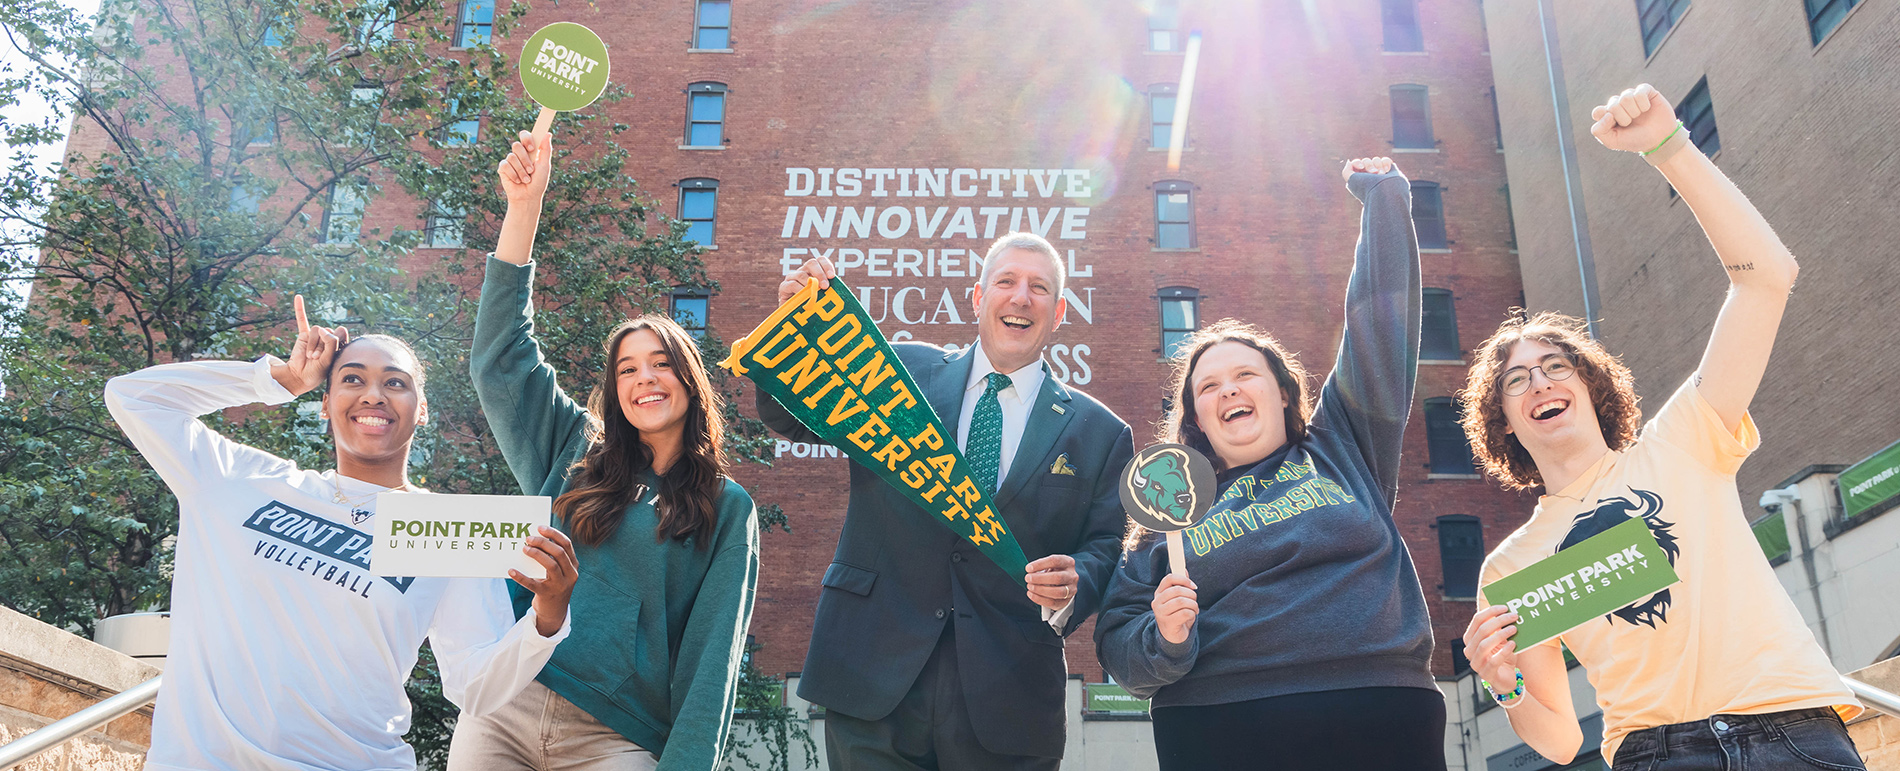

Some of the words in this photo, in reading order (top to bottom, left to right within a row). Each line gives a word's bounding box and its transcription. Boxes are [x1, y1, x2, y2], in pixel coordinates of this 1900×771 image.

[534, 51, 585, 85] PARK
[540, 38, 599, 74] POINT
[530, 66, 586, 96] UNIVERSITY
[785, 167, 1092, 198] DISTINCTIVE
[781, 206, 1091, 240] INNOVATIVE
[792, 287, 918, 418] POINT
[908, 422, 1007, 542] PARK
[752, 321, 995, 547] UNIVERSITY
[775, 439, 849, 459] POIN
[1849, 478, 1873, 497] POINT
[1872, 467, 1895, 486] PARK
[252, 505, 346, 549] POINT
[391, 520, 466, 538] POINT
[468, 522, 532, 539] PARK
[253, 540, 373, 599] VOLLEYBALL
[1506, 572, 1577, 614] POINT
[1577, 543, 1646, 584] PARK
[1516, 559, 1649, 625] UNIVERSITY
[1514, 750, 1543, 768] COFFE
